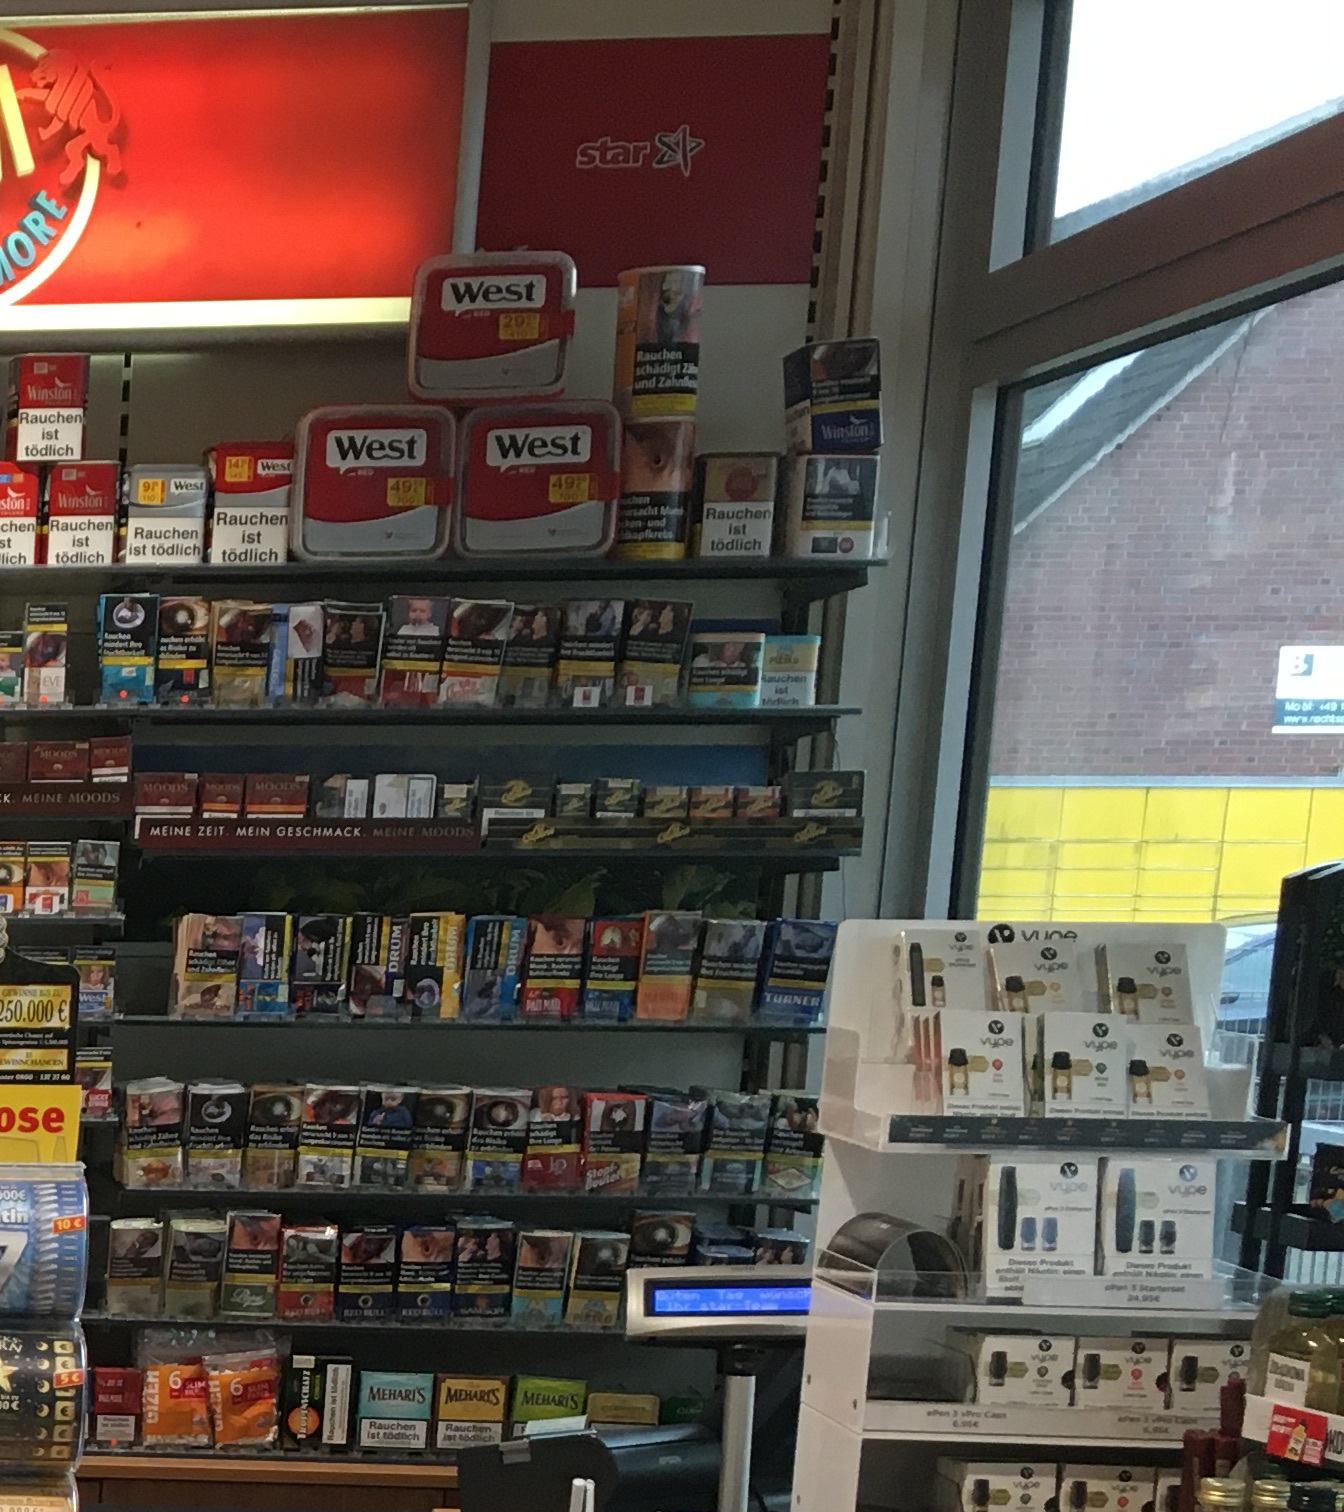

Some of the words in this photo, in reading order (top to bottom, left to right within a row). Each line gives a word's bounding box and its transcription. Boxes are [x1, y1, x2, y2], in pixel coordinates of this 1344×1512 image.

[576, 136, 650, 168] star
[451, 278, 537, 305] West
[19, 411, 83, 426] Rauchen
[41, 428, 59, 441] ist
[24, 442, 75, 457] tödlich
[334, 434, 420, 462] West
[494, 432, 582, 458] West
[216, 511, 288, 529] Rauchen
[240, 530, 262, 545] ist
[220, 546, 278, 564] tödlich
[150, 825, 194, 838] MEINE
[236, 825, 269, 838] MEIN
[58, 1000, 67, 1022] €
[981, 1035, 1014, 1049] vype
